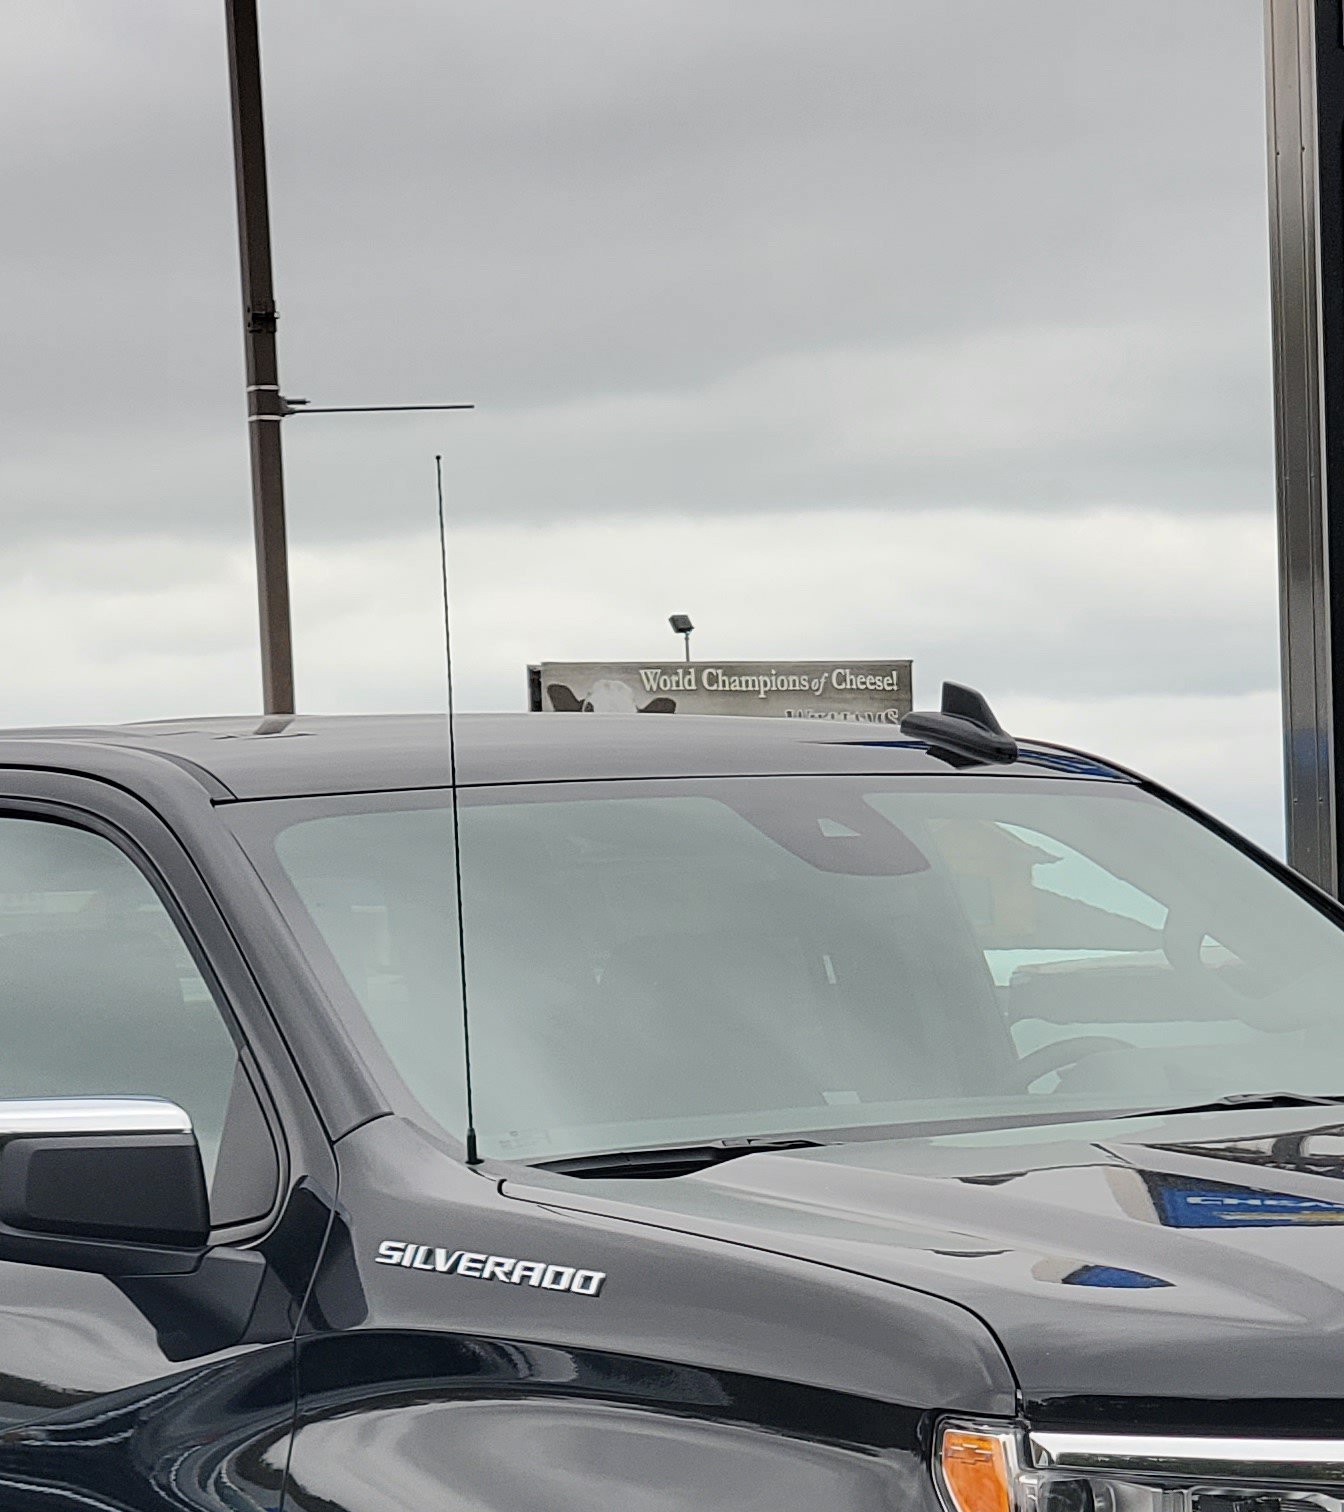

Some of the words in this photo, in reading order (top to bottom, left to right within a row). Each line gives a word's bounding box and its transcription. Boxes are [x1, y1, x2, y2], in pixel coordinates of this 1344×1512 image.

[639, 668, 696, 691] World
[702, 668, 809, 698] Champions
[811, 672, 828, 695] of
[831, 668, 898, 691] Cheese!
[375, 1240, 606, 1297] SILVERADO
